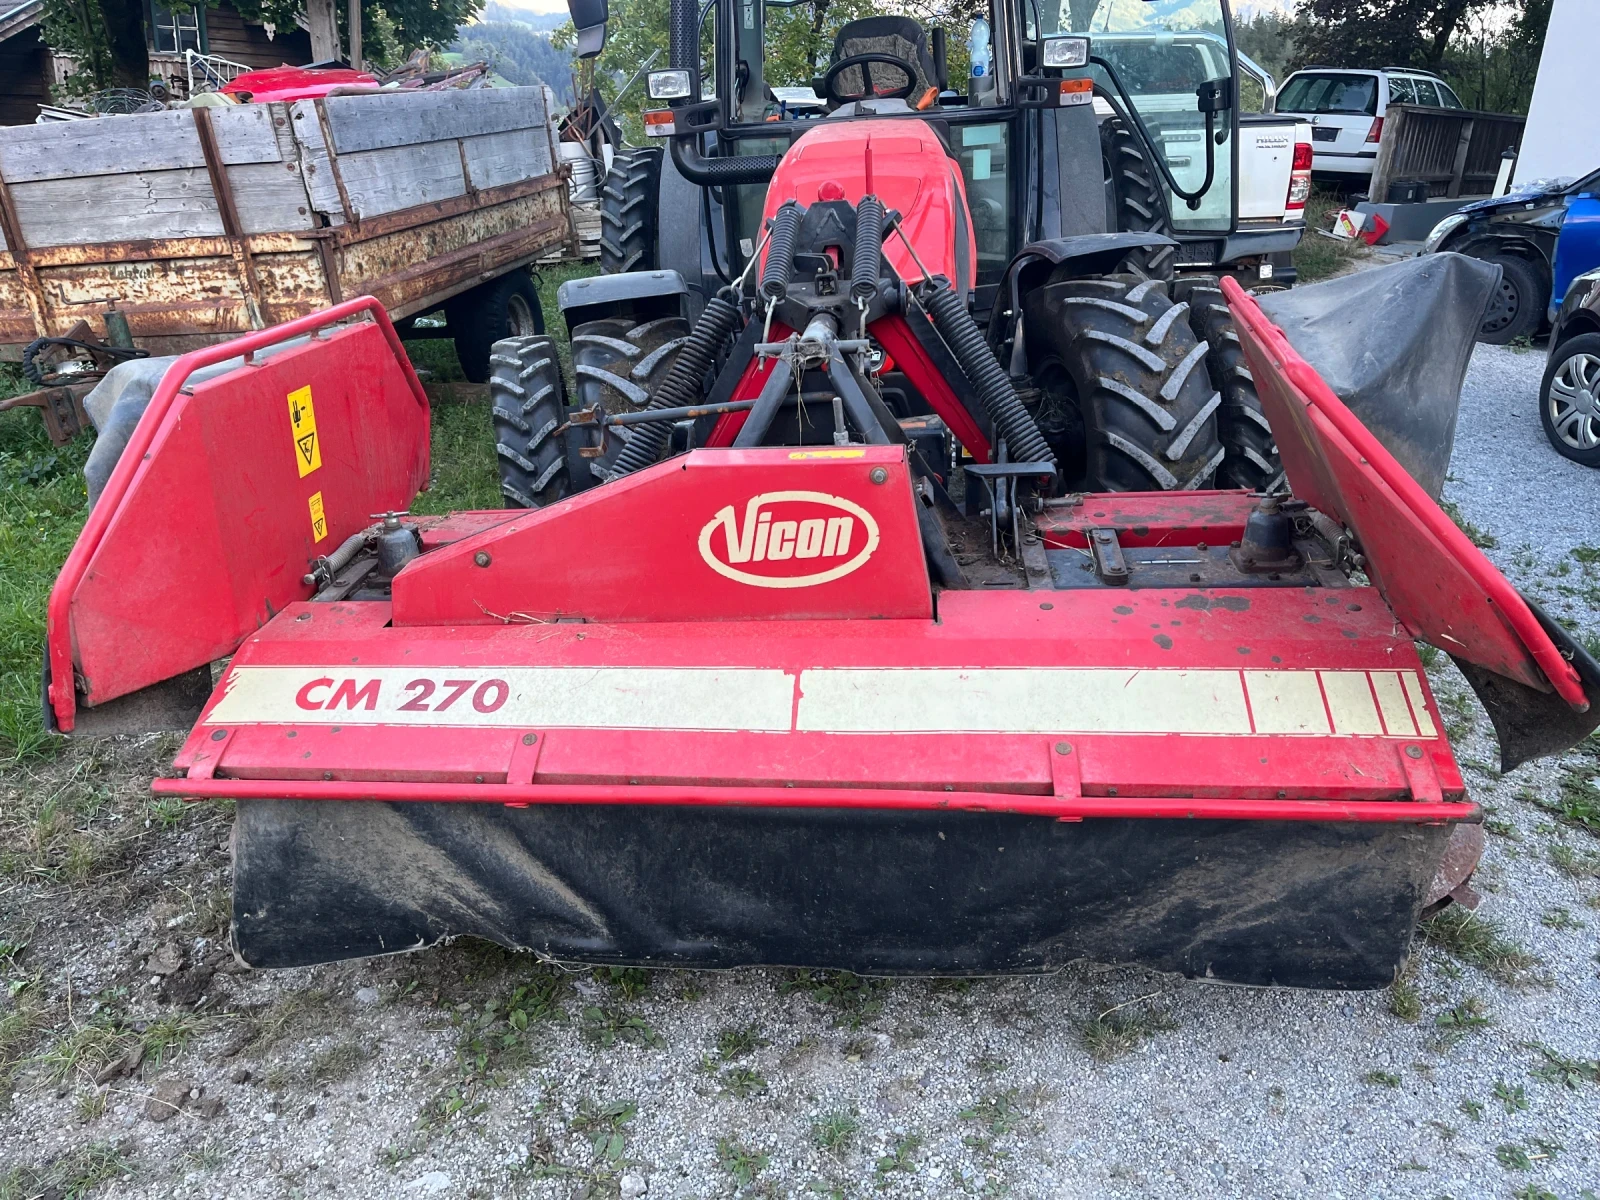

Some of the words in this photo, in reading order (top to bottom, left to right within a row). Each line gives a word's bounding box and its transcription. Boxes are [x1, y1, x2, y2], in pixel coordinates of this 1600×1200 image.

[714, 498, 854, 563] Vicon
[295, 676, 382, 711] CM
[396, 678, 510, 713] 270
